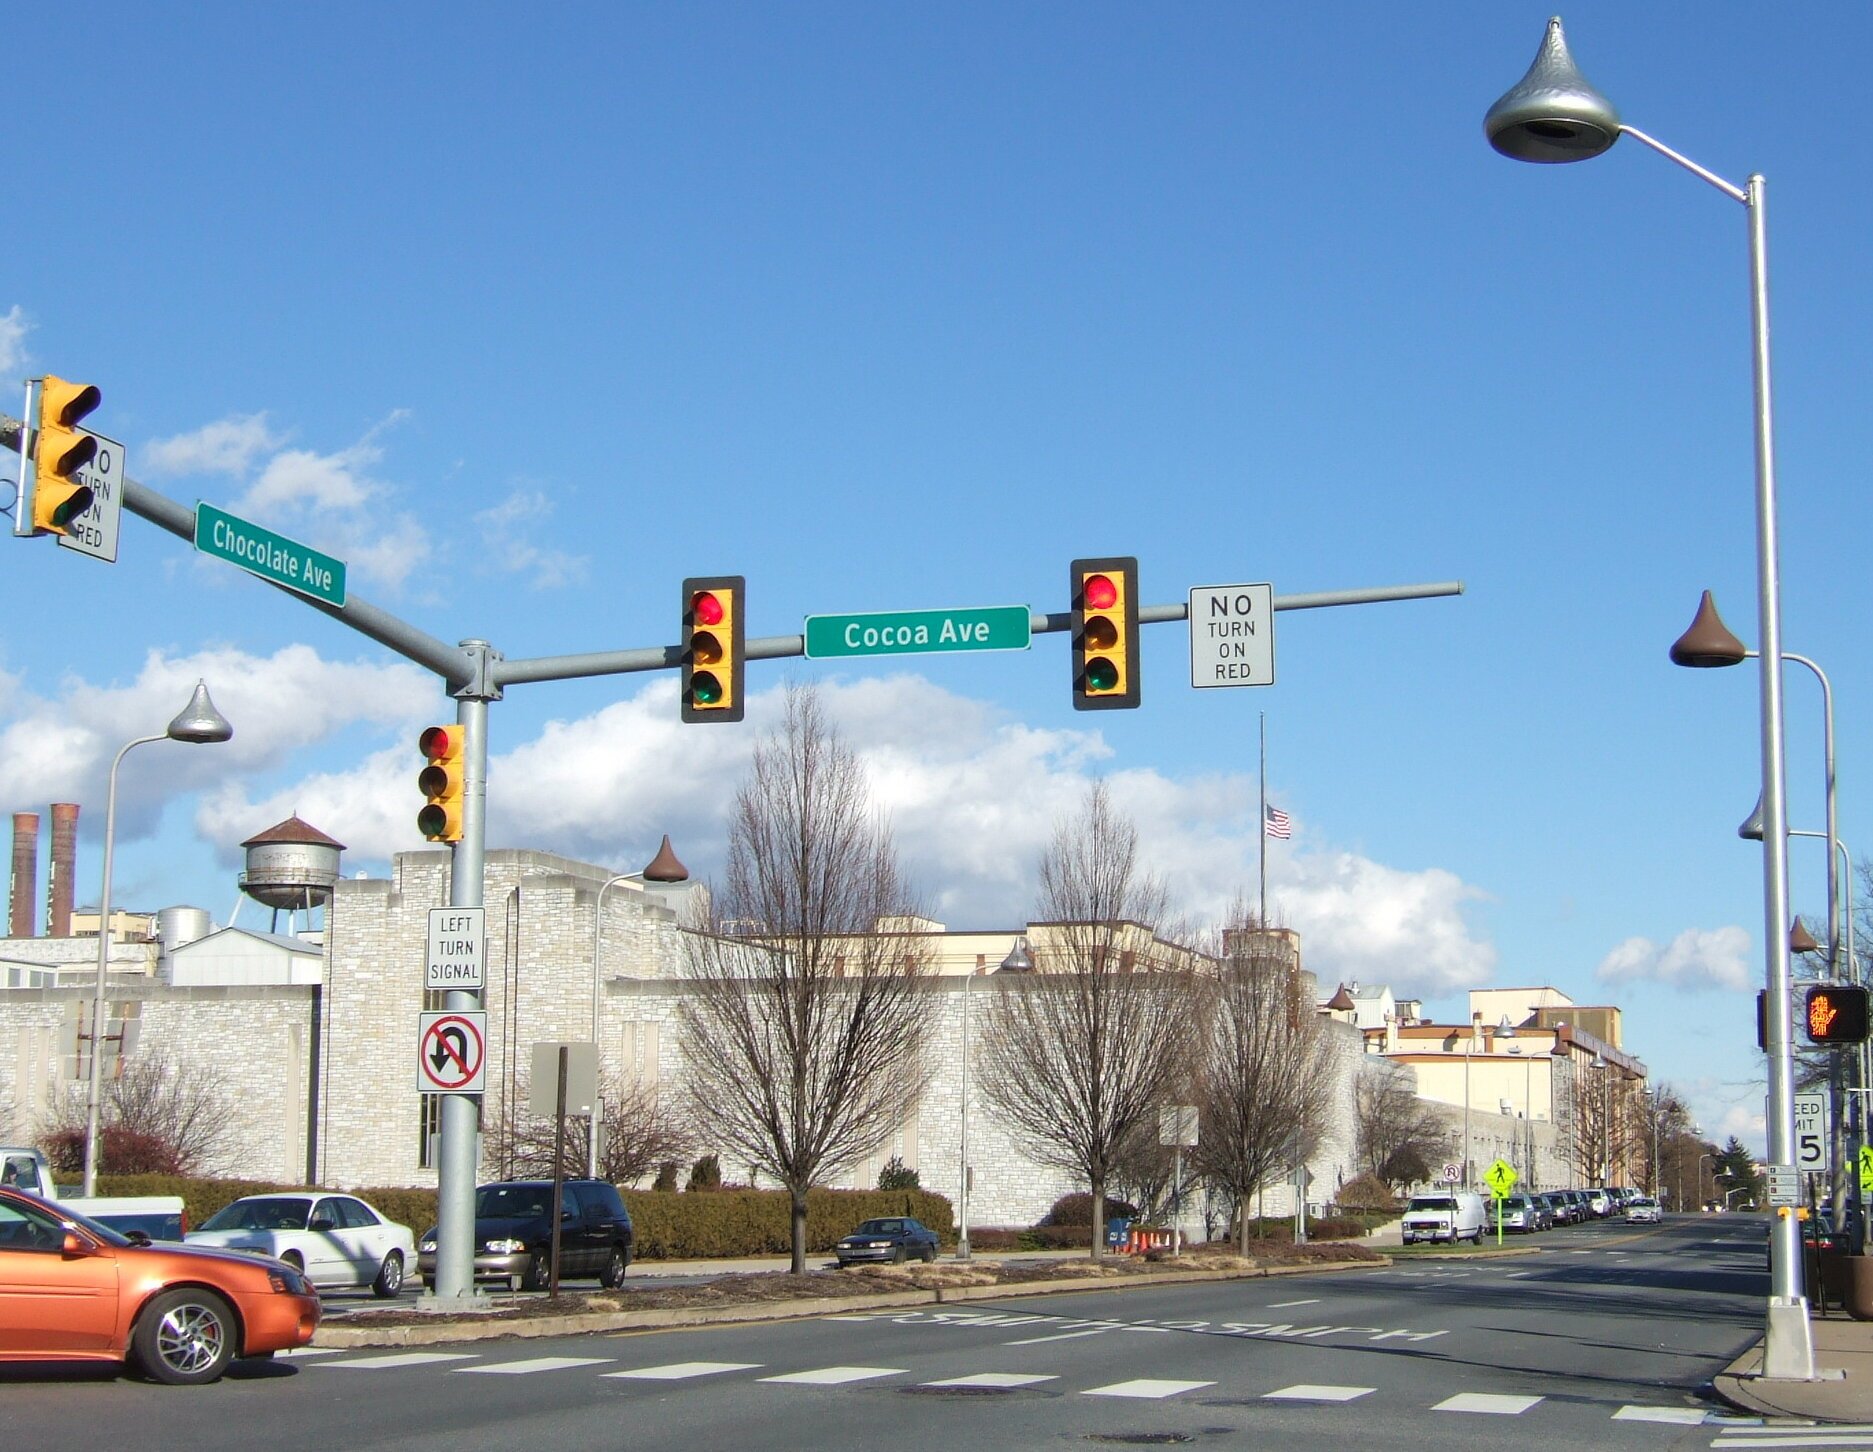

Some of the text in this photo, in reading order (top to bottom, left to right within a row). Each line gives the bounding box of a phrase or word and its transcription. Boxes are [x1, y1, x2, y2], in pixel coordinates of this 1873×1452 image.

[89, 450, 111, 474] O
[78, 472, 111, 501] TURN
[76, 523, 103, 548] RED
[213, 520, 332, 591] Chocolate Ave
[1211, 595, 1252, 617] NO
[845, 618, 990, 648] Cocoa Ave
[1209, 620, 1255, 638] TURN
[1219, 643, 1246, 658] ON
[1215, 663, 1251, 680] RED
[441, 917, 472, 932] LEFT
[439, 941, 474, 955] TURN
[431, 964, 478, 979] SIGNAL
[1794, 1103, 1820, 1115] EED
[1801, 1135, 1821, 1162] 5
